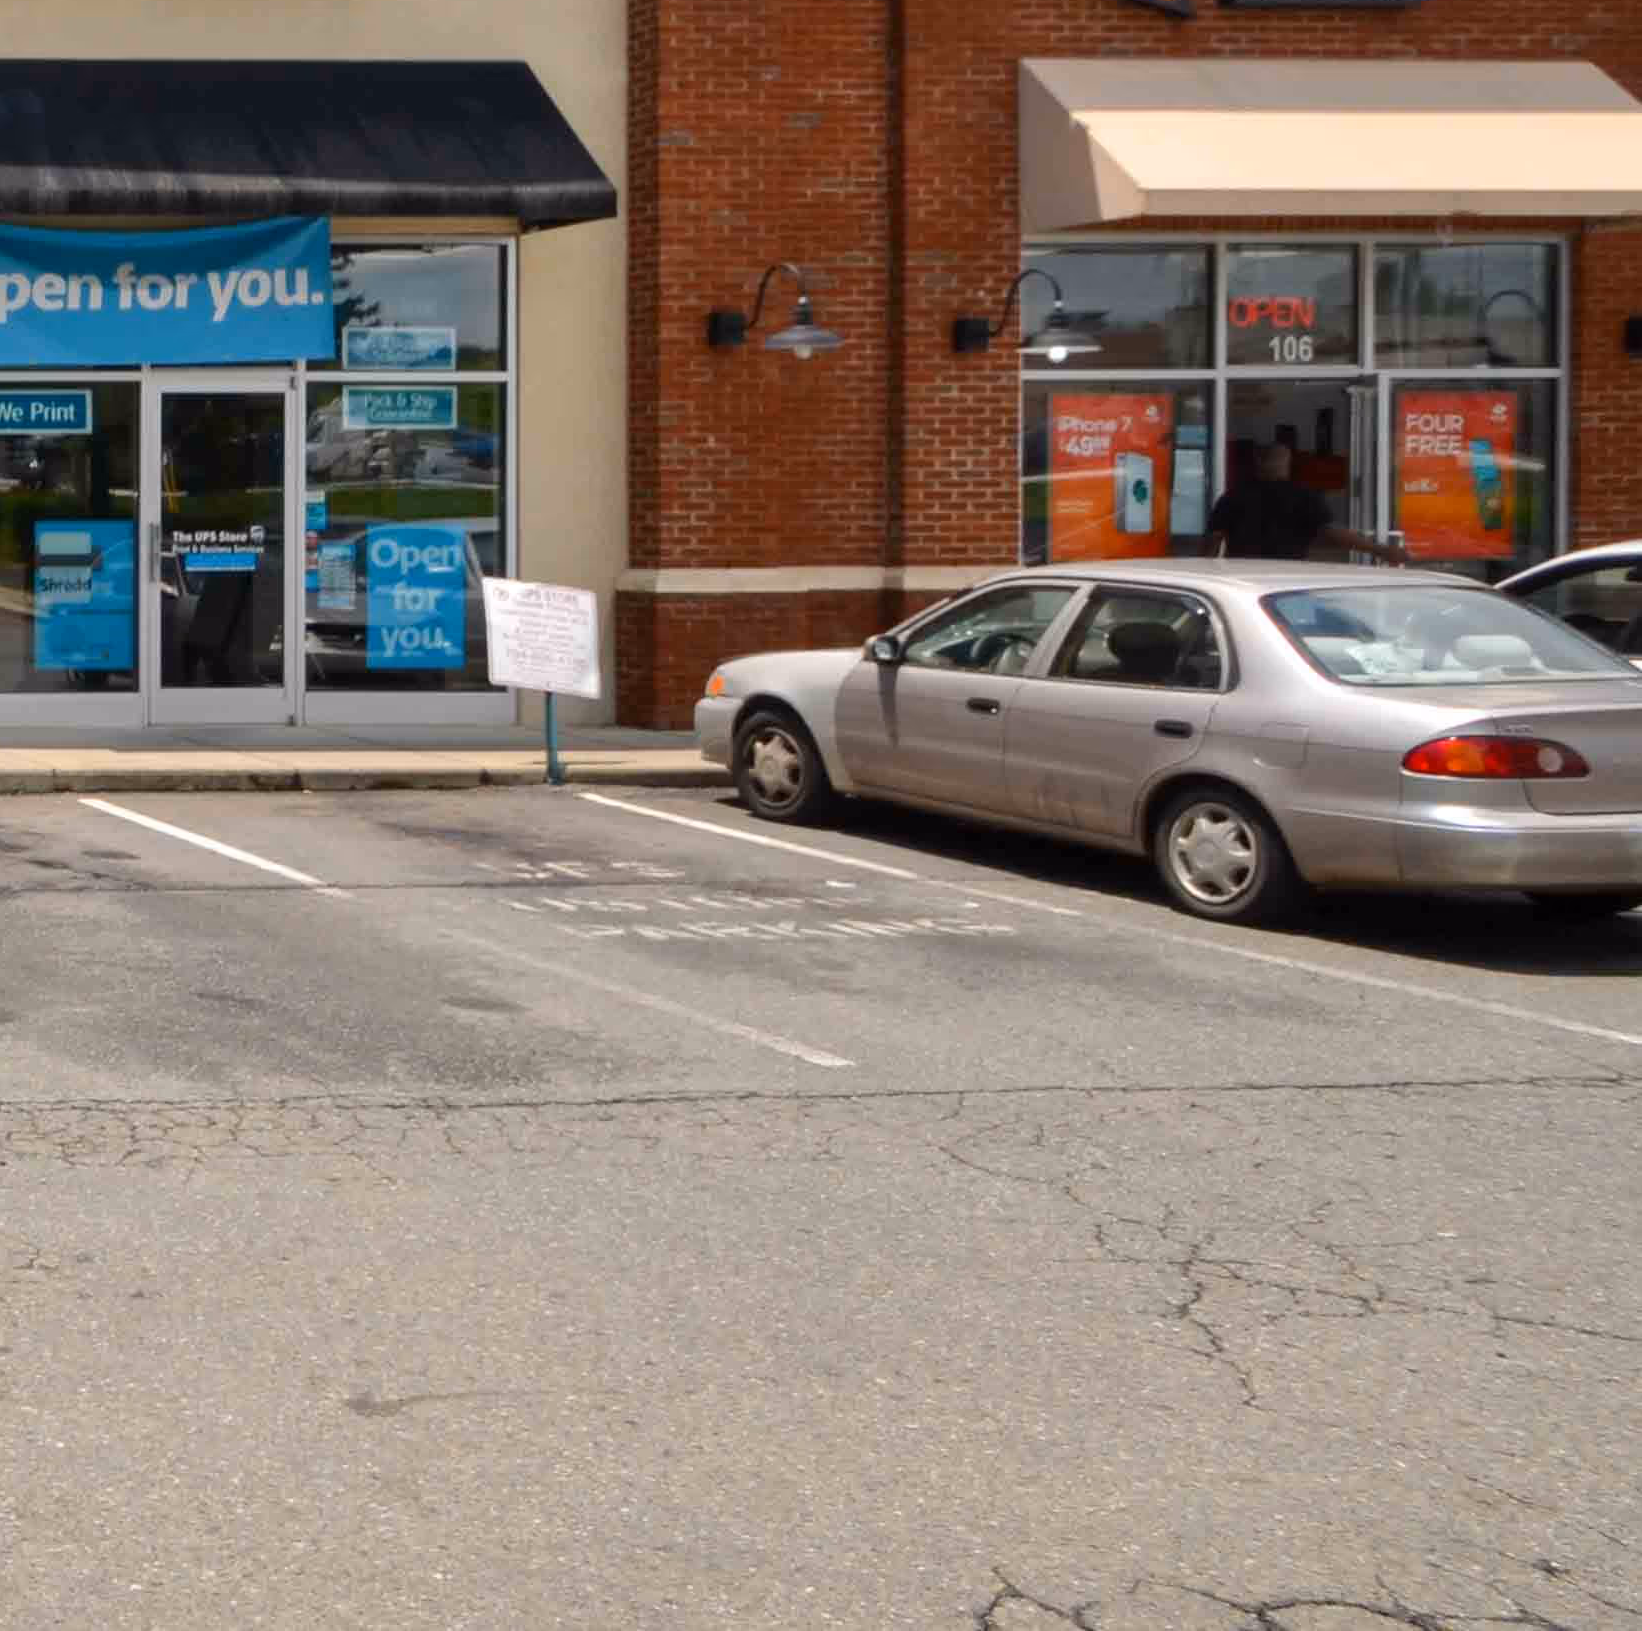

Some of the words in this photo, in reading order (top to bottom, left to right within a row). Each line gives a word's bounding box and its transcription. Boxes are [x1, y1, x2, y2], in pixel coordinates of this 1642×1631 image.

[112, 260, 202, 311] for
[209, 267, 326, 322] you.
[1228, 297, 1315, 329] OPEN
[1268, 336, 1314, 362] 106
[31, 401, 76, 422] Print
[1405, 414, 1463, 433] FOUR
[1405, 435, 1461, 455] FREE
[173, 531, 192, 542] The
[194, 531, 216, 542] UPS
[219, 531, 247, 542] Store
[371, 539, 461, 573] Open
[394, 581, 437, 610] for
[381, 626, 451, 657] you.
